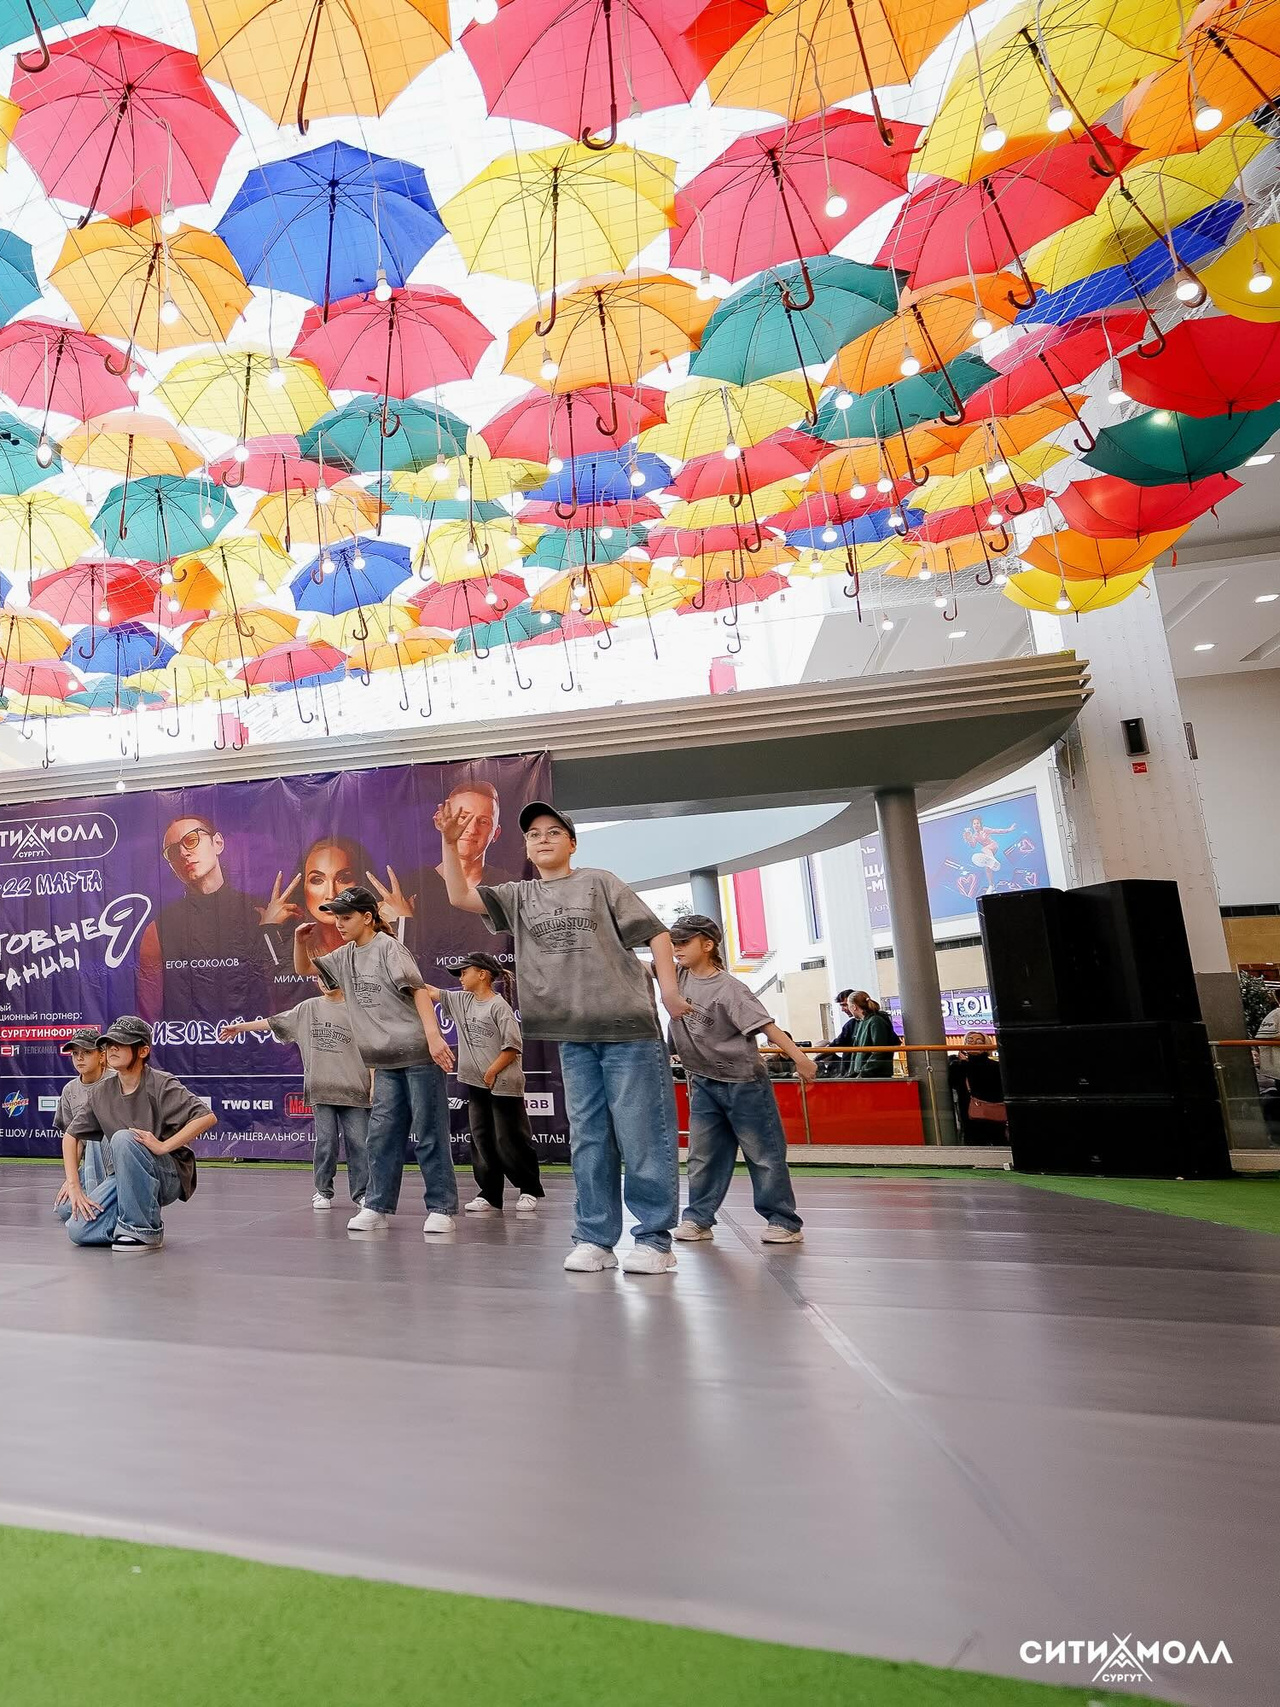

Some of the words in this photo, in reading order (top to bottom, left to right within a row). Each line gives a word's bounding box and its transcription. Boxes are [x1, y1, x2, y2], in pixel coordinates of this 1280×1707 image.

[18, 850, 45, 858] СУРГУТ
[36, 870, 102, 896] МАРТА
[566, 916, 598, 933] STUDIO
[166, 960, 189, 969] ЕГОР
[190, 958, 240, 968] СОКОЛОВ
[436, 954, 464, 966] ИГОР
[274, 975, 304, 984] МИЛА
[40, 1012, 83, 1021] партнер:
[221, 1100, 251, 1110] TWO
[253, 1100, 273, 1110] KEI
[5, 1129, 27, 1138] ШОУ
[225, 1131, 306, 1142] ТАНЦЕВАЛЬНОЕ
